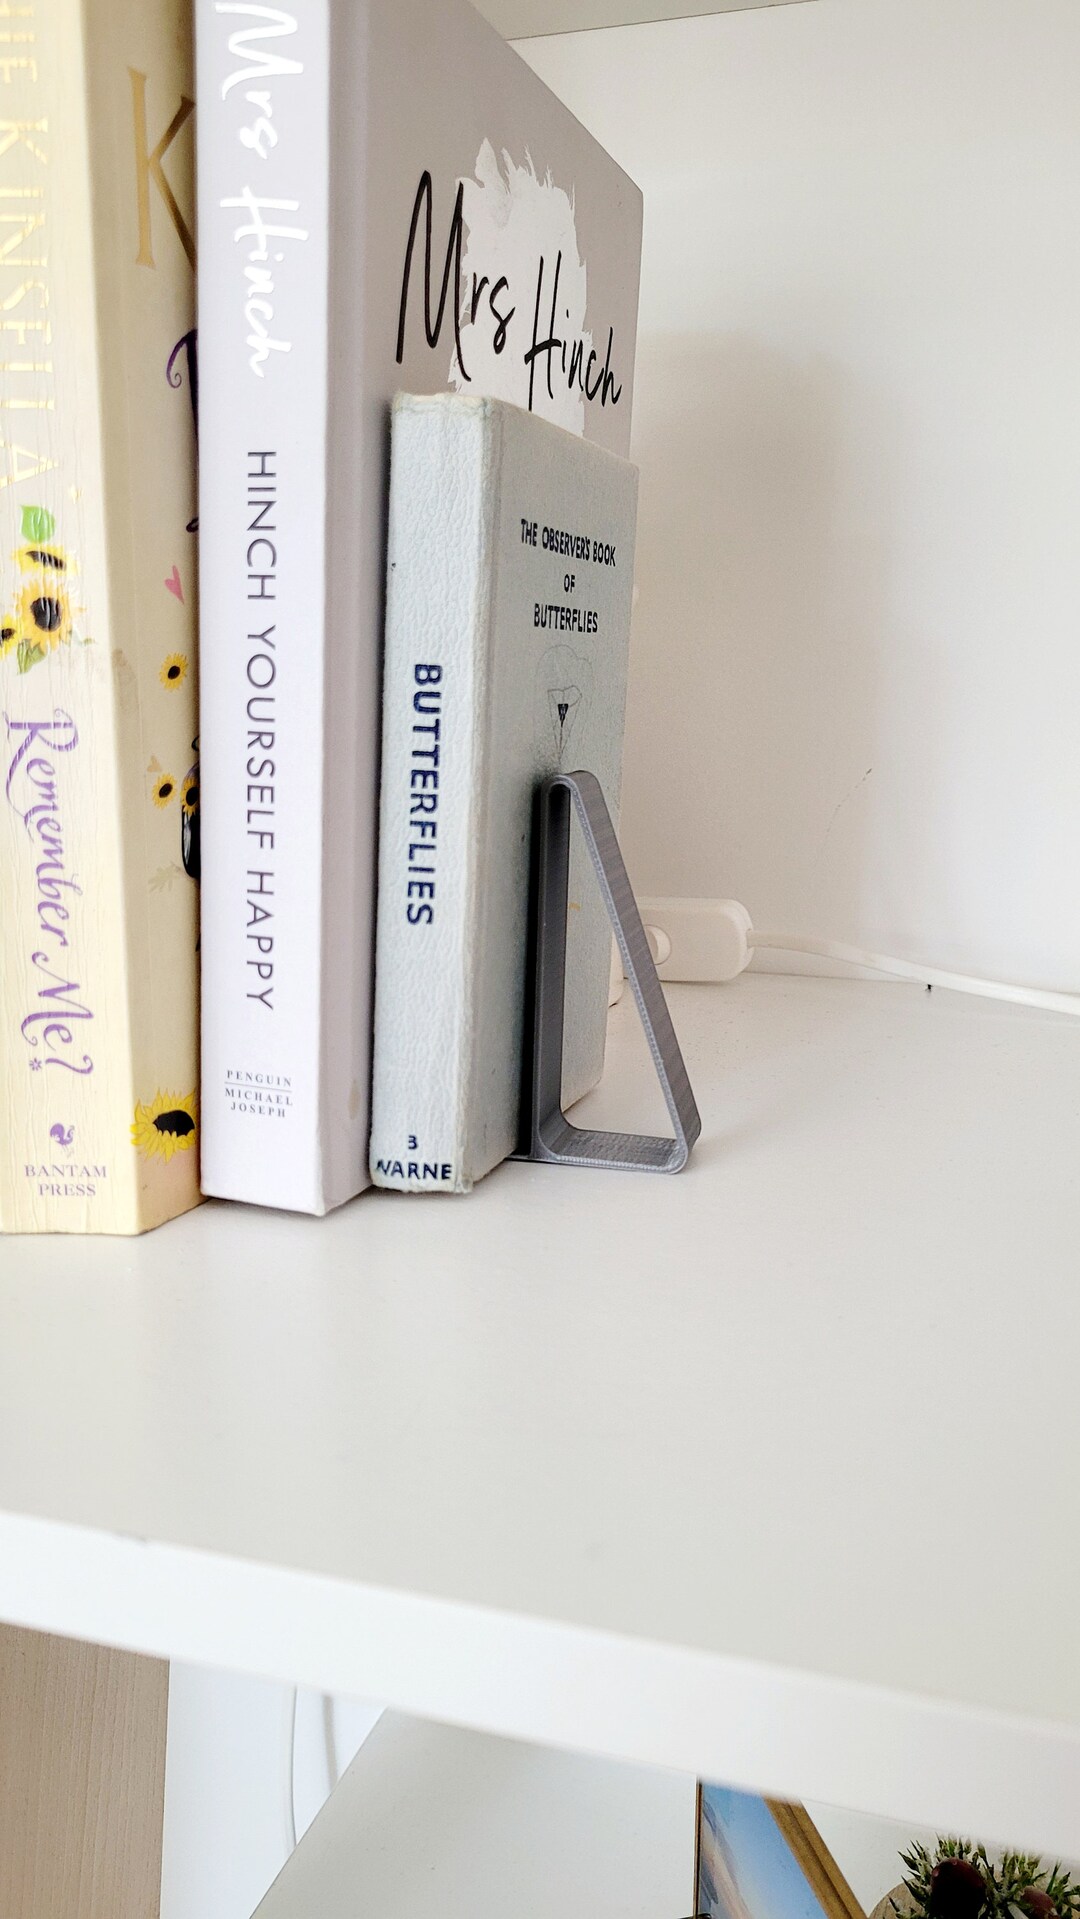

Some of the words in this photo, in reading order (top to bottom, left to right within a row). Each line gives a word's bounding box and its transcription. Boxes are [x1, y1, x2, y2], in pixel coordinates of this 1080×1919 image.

[215, 2, 304, 159] Mrs
[219, 184, 309, 378] Hinch
[396, 170, 515, 382] Mrs
[524, 250, 622, 411] Hinch
[246, 450, 277, 601] HINCH
[521, 518, 538, 547] THE
[542, 526, 590, 561] OBSERVER'S
[593, 541, 616, 567] BOOK
[564, 574, 576, 593] OF
[534, 603, 598, 633] BUTTERFLIES
[245, 624, 277, 850] YOURSELF
[406, 664, 443, 925] BUTTERFLIES
[2, 708, 83, 947] Remember
[245, 870, 276, 1011] HAPPY
[225, 1088, 293, 1106] MICHAEL
[227, 1069, 292, 1087] PENGUIN
[231, 1102, 286, 1118] JOSEPH
[408, 1134, 418, 1150] 3
[24, 1164, 108, 1179] BANTAM
[38, 1182, 97, 1196] PRESS
